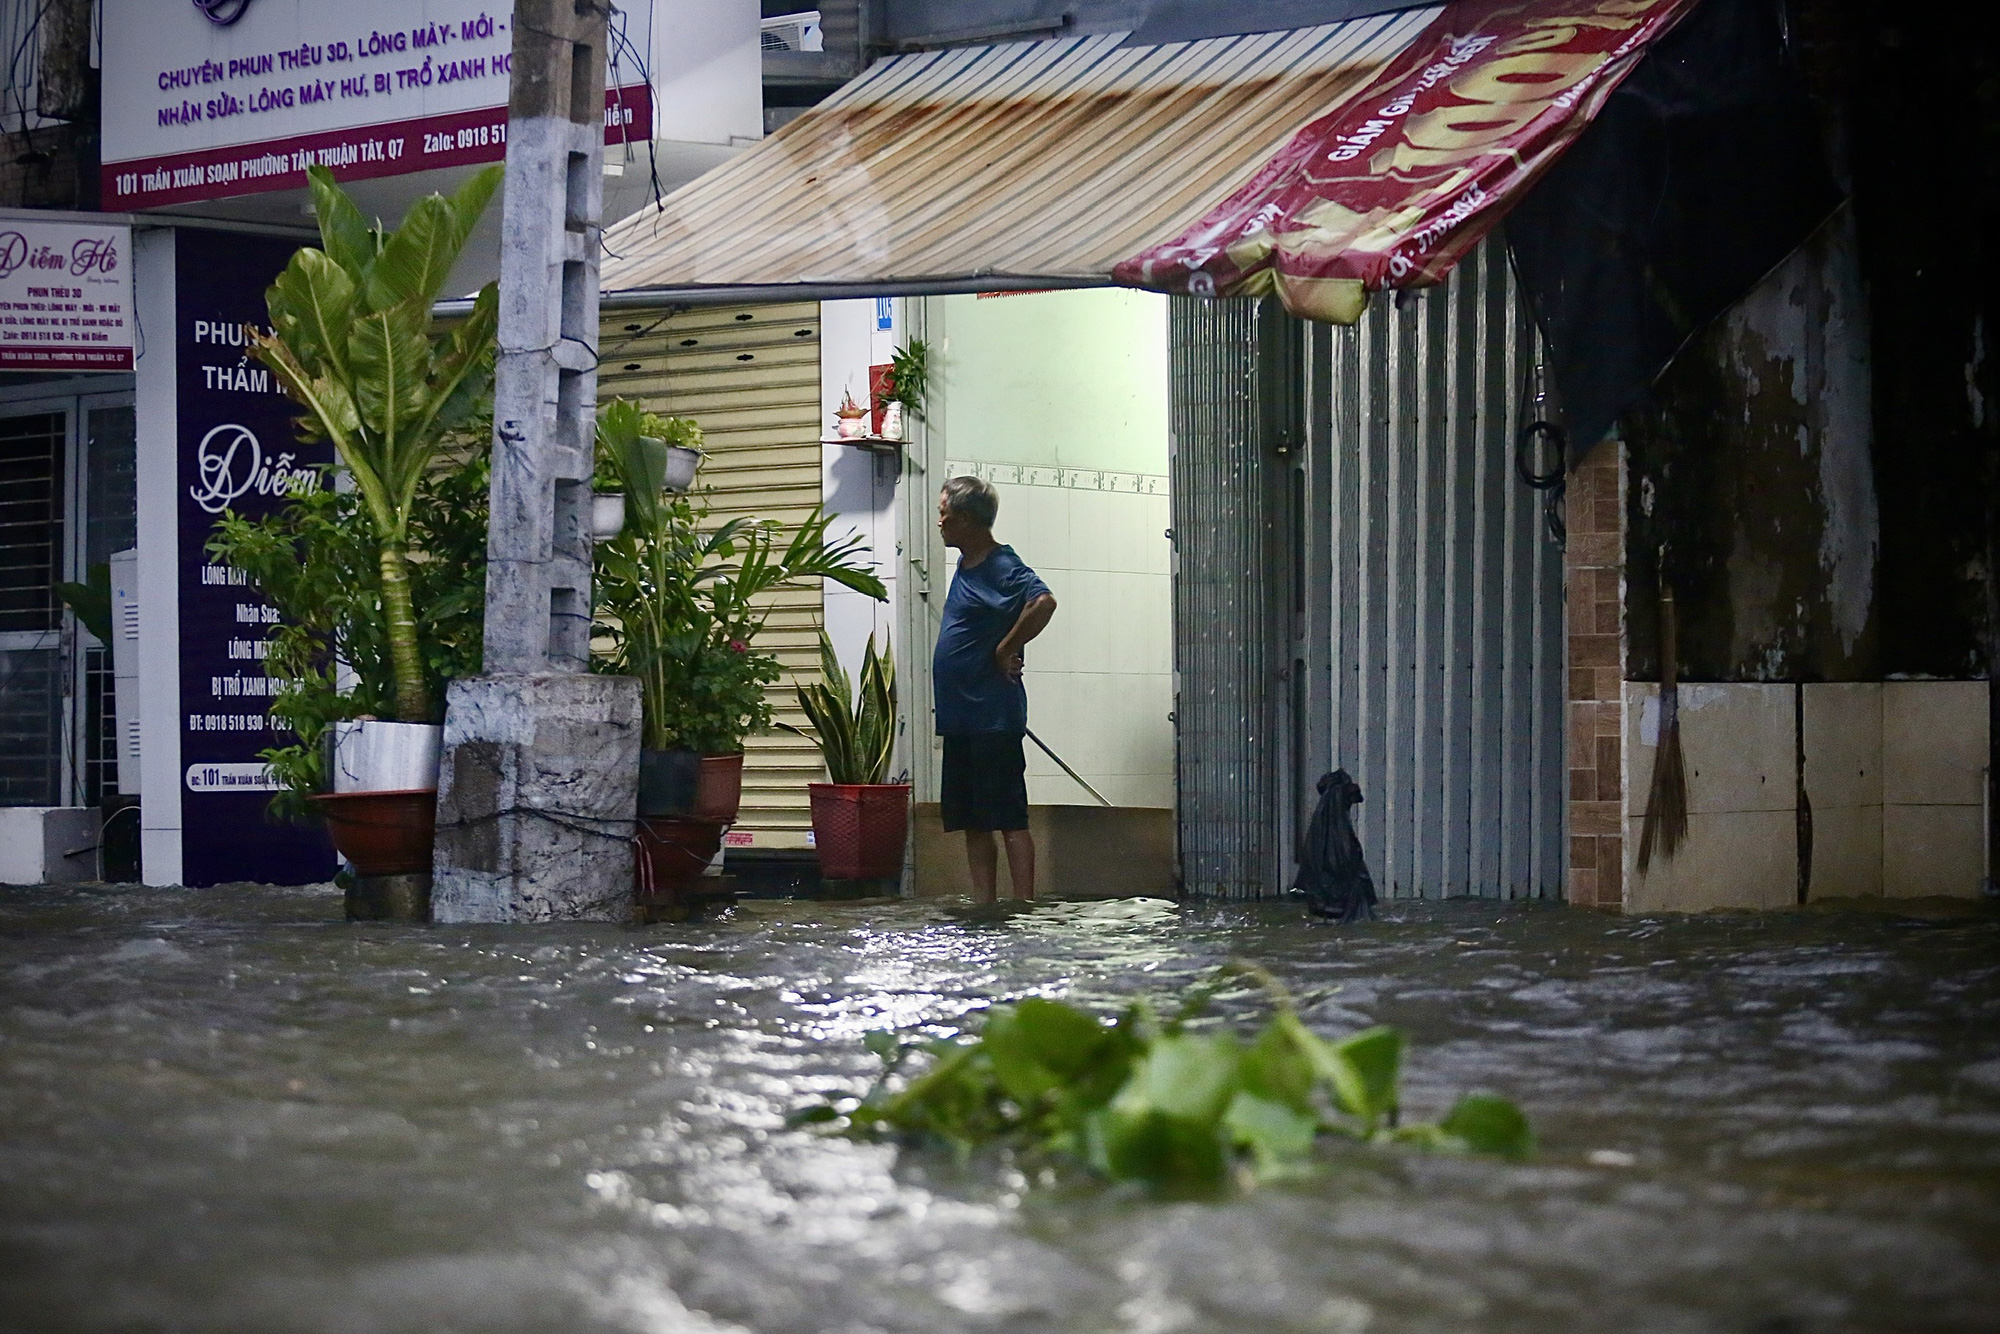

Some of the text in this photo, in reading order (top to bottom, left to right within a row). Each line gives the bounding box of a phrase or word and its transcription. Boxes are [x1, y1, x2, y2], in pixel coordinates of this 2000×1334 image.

[158, 58, 223, 91] CHUYÊN
[229, 54, 273, 79] PHUN
[278, 43, 322, 70] THÊU
[358, 31, 407, 58] LÔNG
[461, 11, 494, 41] MÔI
[158, 100, 201, 127] NHẬN
[206, 91, 244, 119] SỬA:
[249, 87, 295, 113] LÔNG
[299, 79, 335, 106] MÀY
[340, 73, 369, 98] HƯ,
[374, 72, 392, 95] BỊ
[396, 55, 433, 90] TRỔ
[437, 57, 486, 85] XANH
[423, 123, 506, 154] Zalo: 0918 51
[115, 138, 405, 196] 101 TRẦN XUÂN SOẠN PHƯỜNG TÂN THUẬN TÂY, Q7
[27, 286, 48, 298] PHUN
[195, 320, 259, 347] PHUN
[202, 355, 268, 393] THẨM
[190, 423, 317, 514] Diễm
[202, 562, 226, 585] LÔNG
[236, 603, 259, 627] Nhận
[228, 636, 252, 659] LÔNG
[212, 677, 222, 700] BỊ
[242, 677, 266, 696] XANH
[190, 714, 203, 731] ĐT:
[205, 714, 227, 731] 0918
[228, 714, 245, 731] 518
[246, 714, 263, 731] 930
[202, 768, 220, 786] 101
